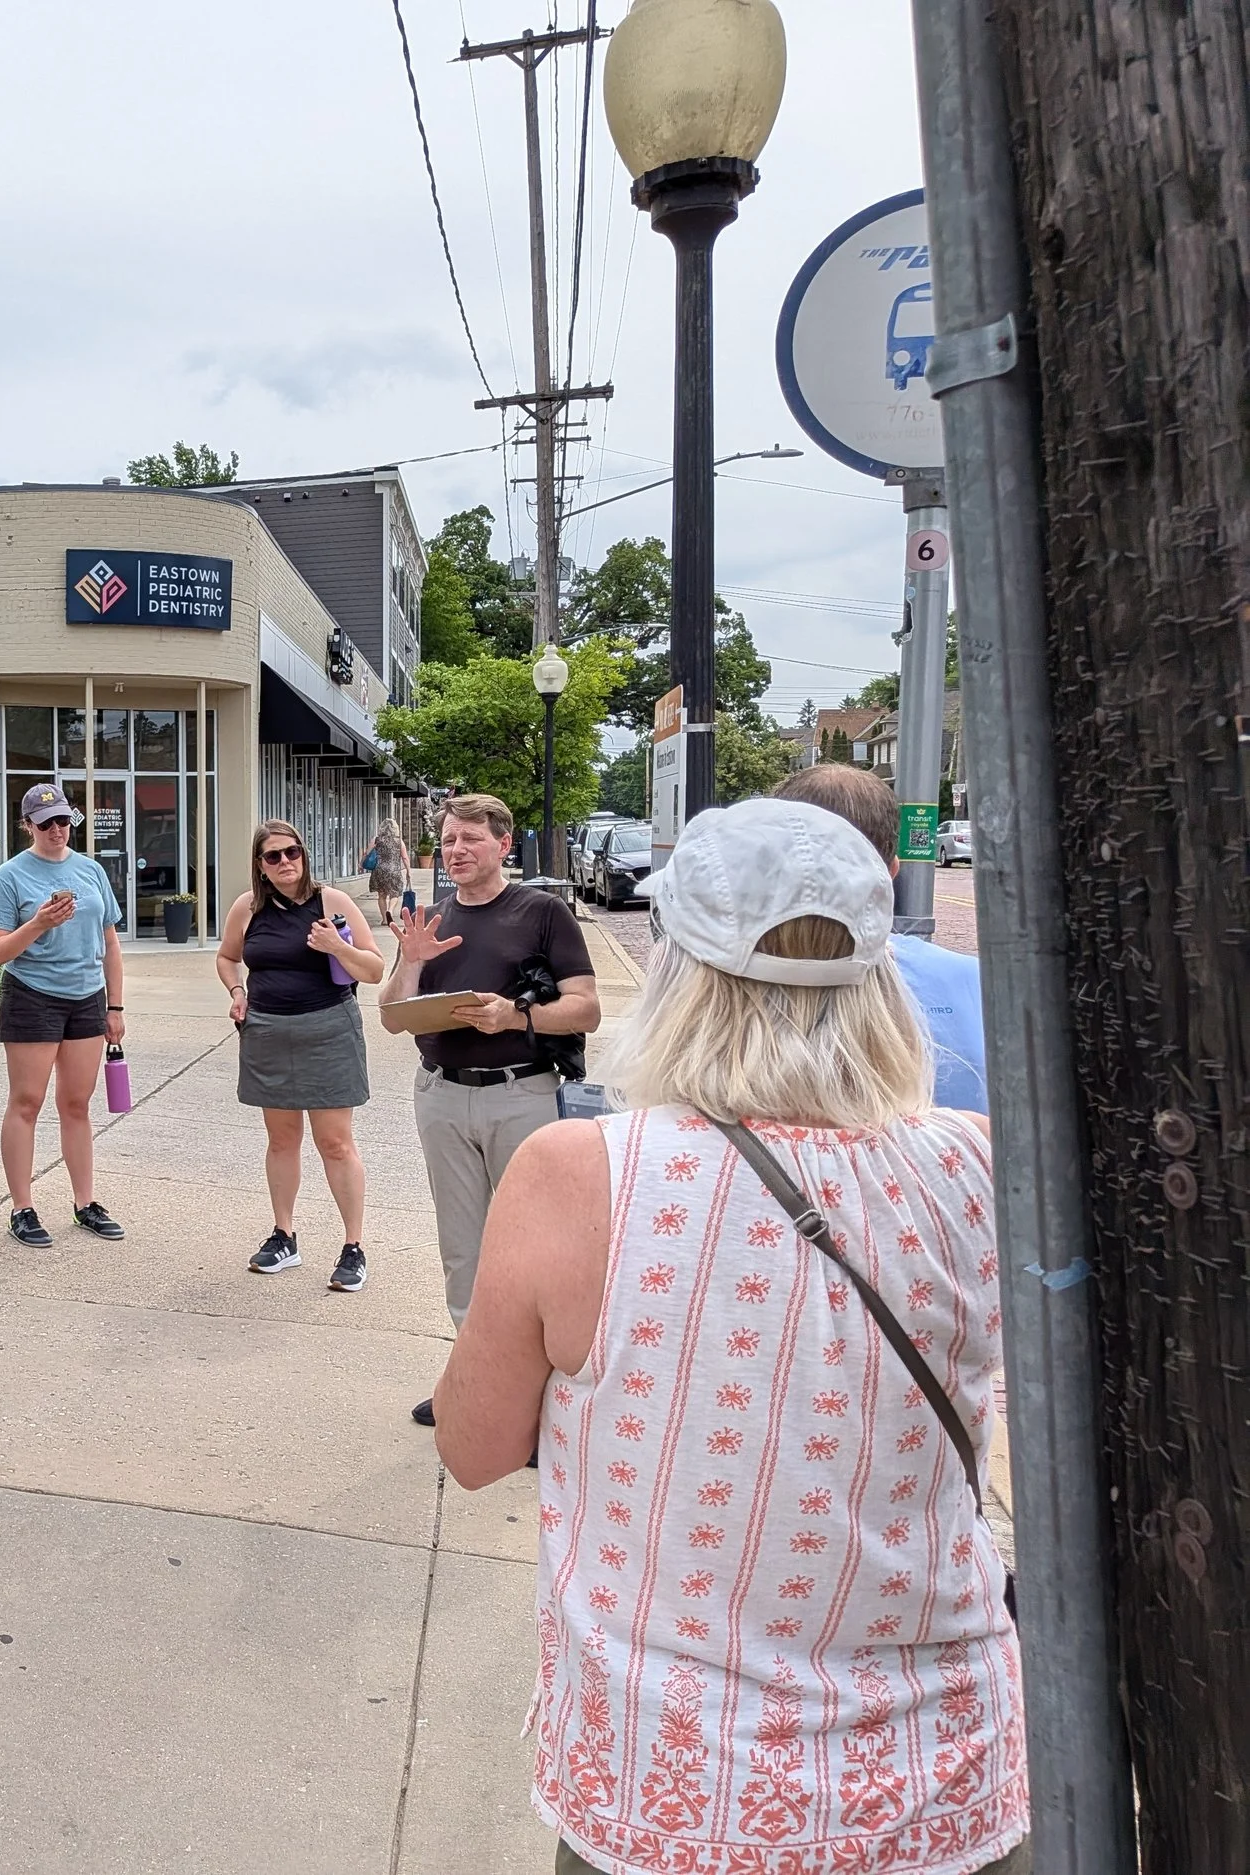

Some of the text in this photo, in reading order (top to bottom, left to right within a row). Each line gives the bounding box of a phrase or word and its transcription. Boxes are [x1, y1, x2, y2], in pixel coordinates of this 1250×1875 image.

[918, 539, 934, 561] 6
[149, 565, 220, 583] EASTOWN
[149, 583, 222, 600] PEDIATRIC
[149, 600, 225, 617] DENTISTRY
[527, 829, 534, 838] P
